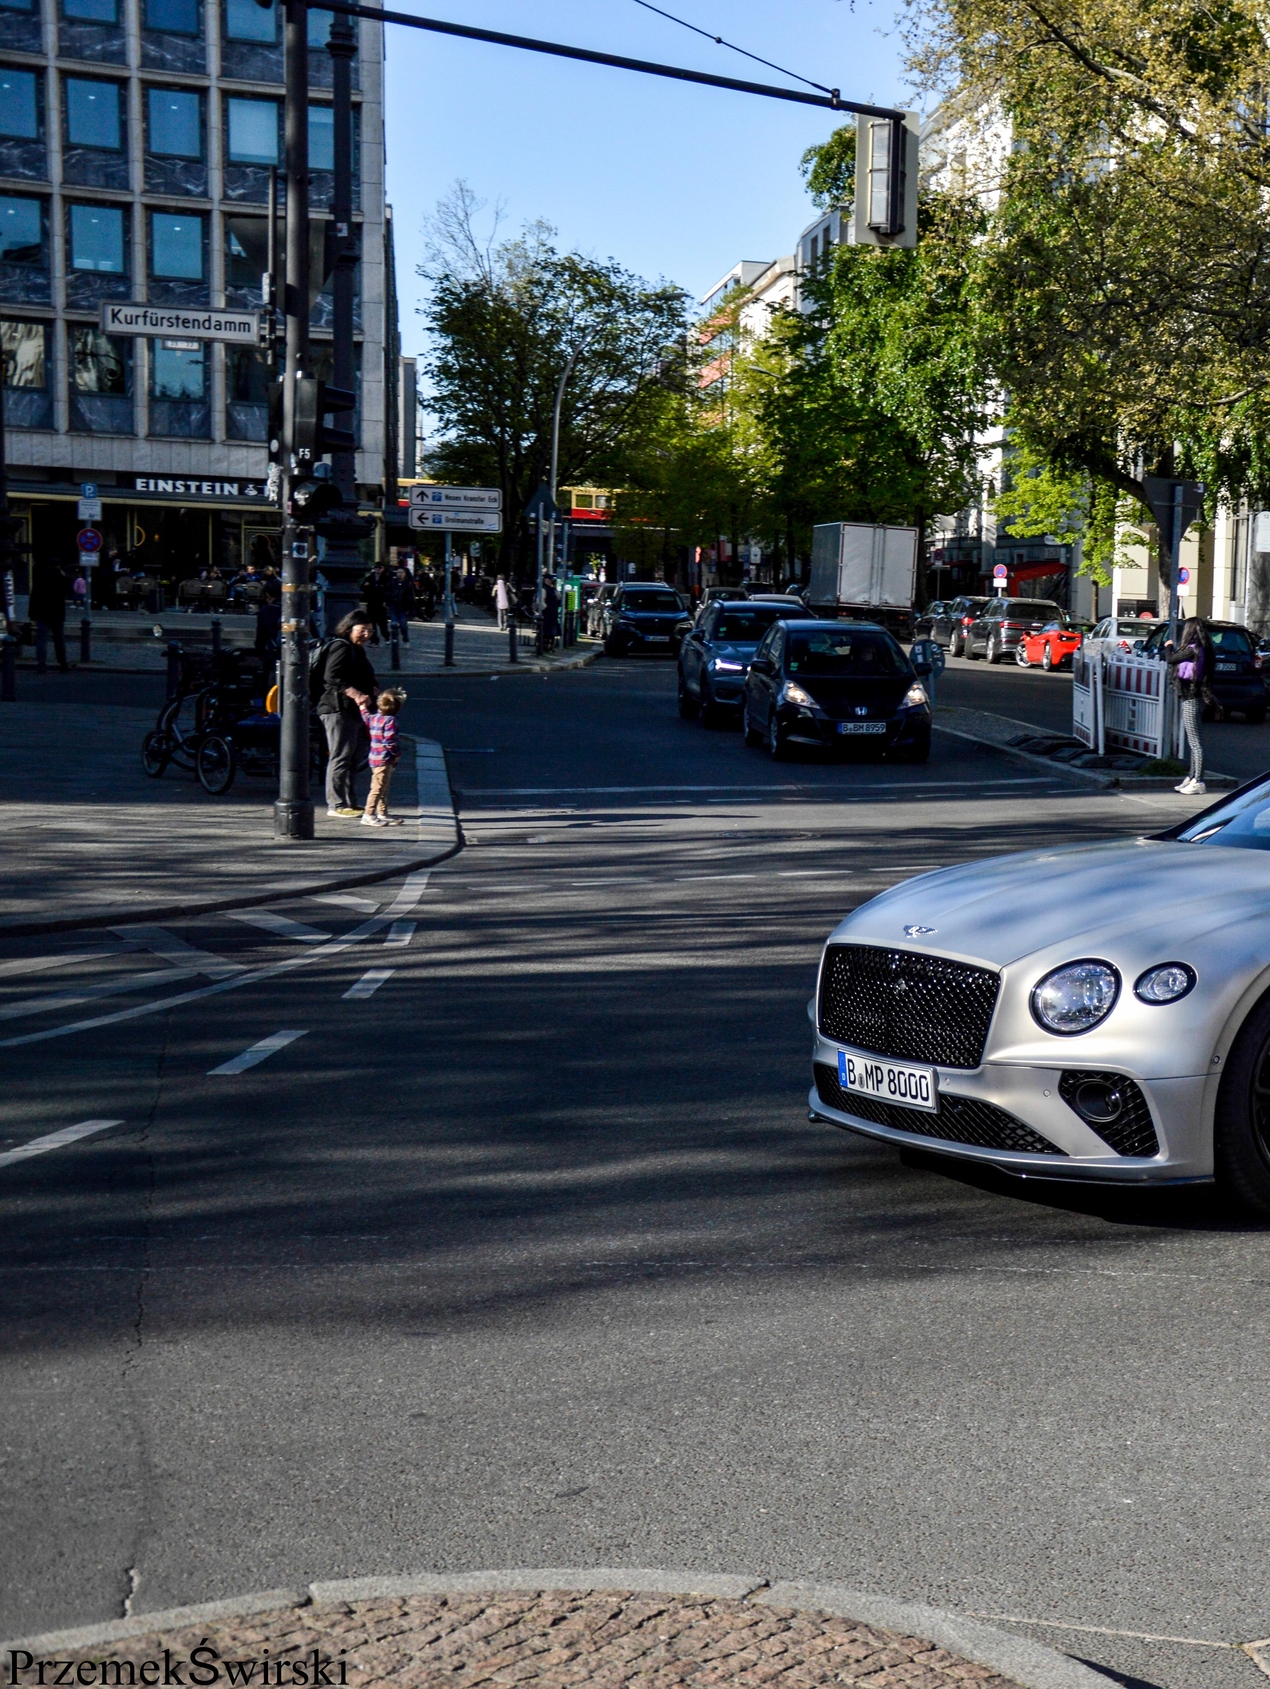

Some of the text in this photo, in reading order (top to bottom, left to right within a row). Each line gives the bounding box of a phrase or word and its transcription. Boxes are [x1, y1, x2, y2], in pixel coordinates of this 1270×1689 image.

[111, 307, 251, 333] Kurfürstendamm
[299, 448, 311, 459] F5
[135, 478, 239, 496] EINSTEIN
[847, 1058, 930, 1102] B MP 8000
